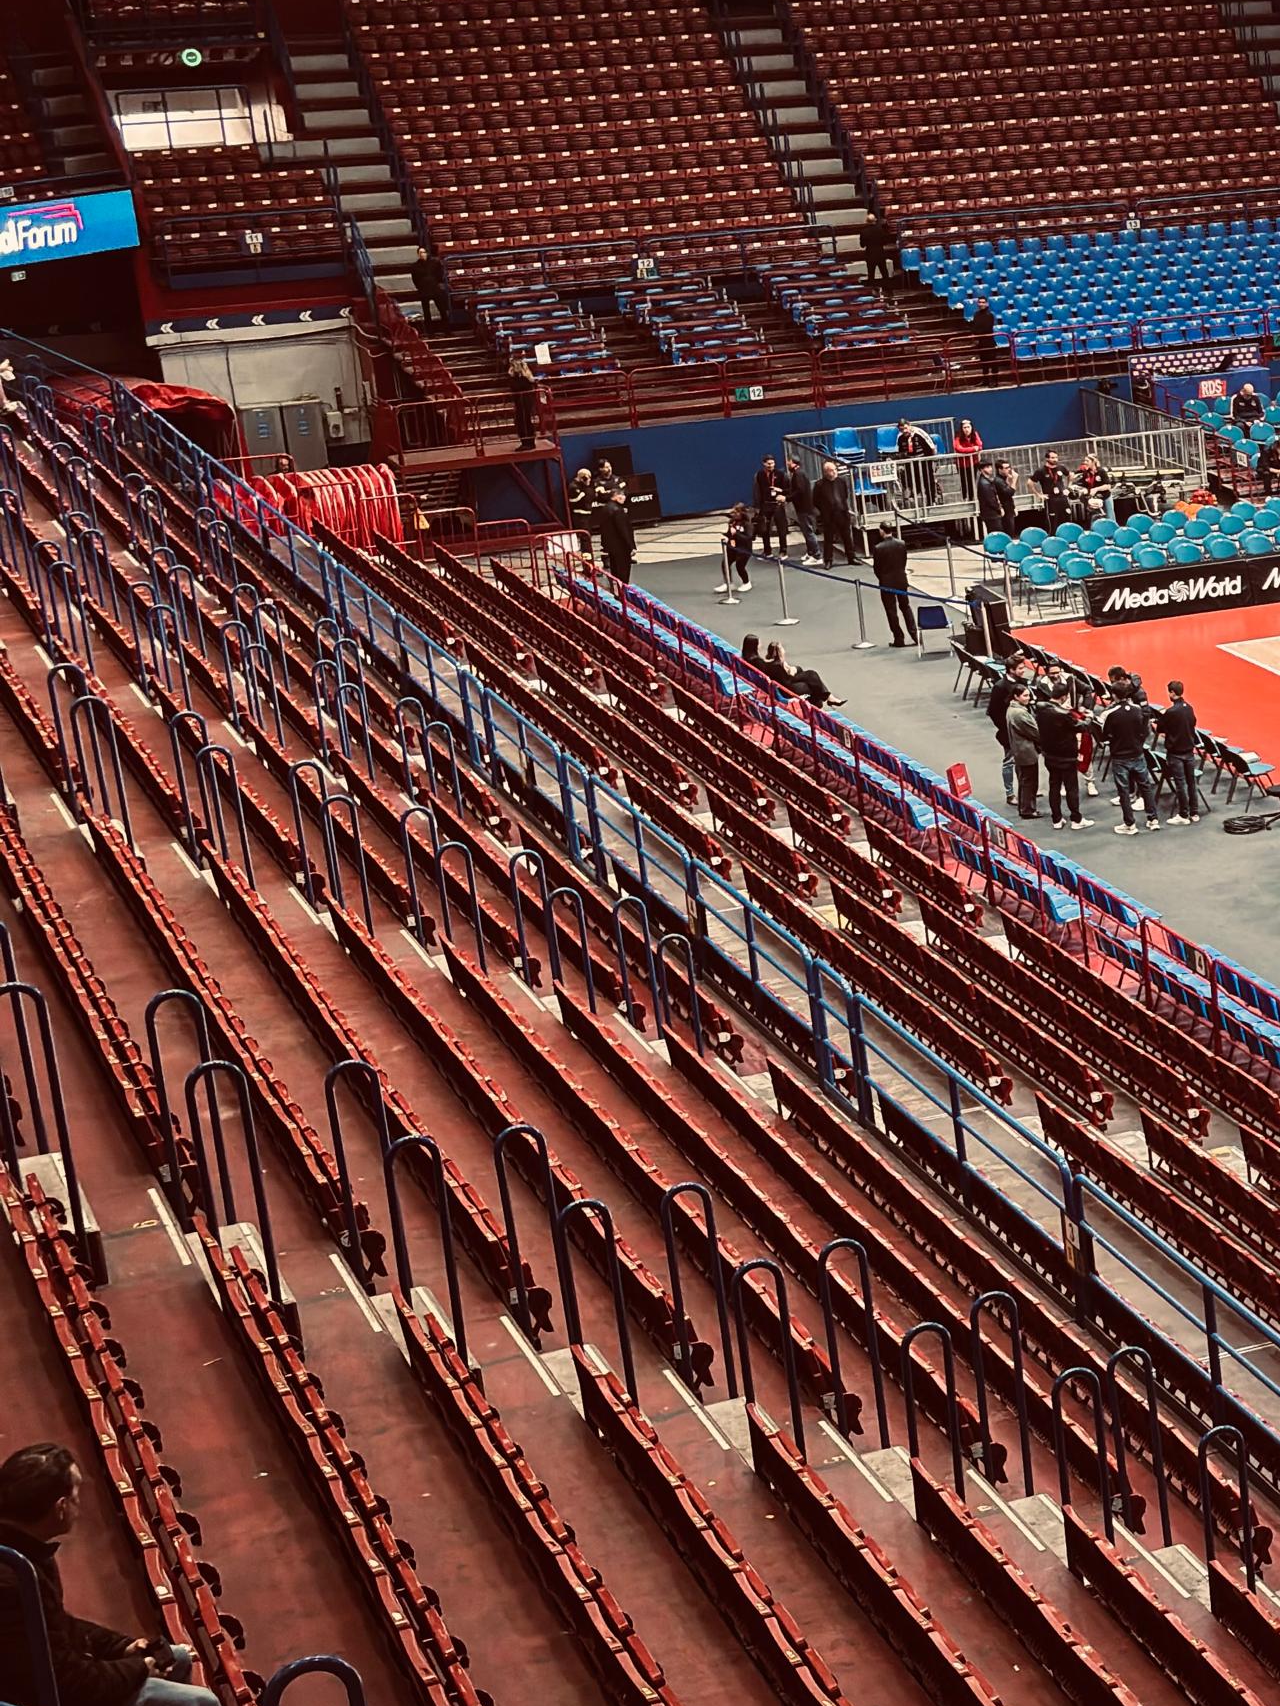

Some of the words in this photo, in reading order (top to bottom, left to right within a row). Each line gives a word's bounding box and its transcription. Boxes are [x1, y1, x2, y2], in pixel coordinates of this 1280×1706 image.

[1129, 221, 1139, 229] 13
[640, 260, 654, 269] 12
[1201, 379, 1223, 396] RDS
[751, 389, 762, 399] 12
[1102, 586, 1169, 613] Media
[1187, 575, 1243, 605] World
